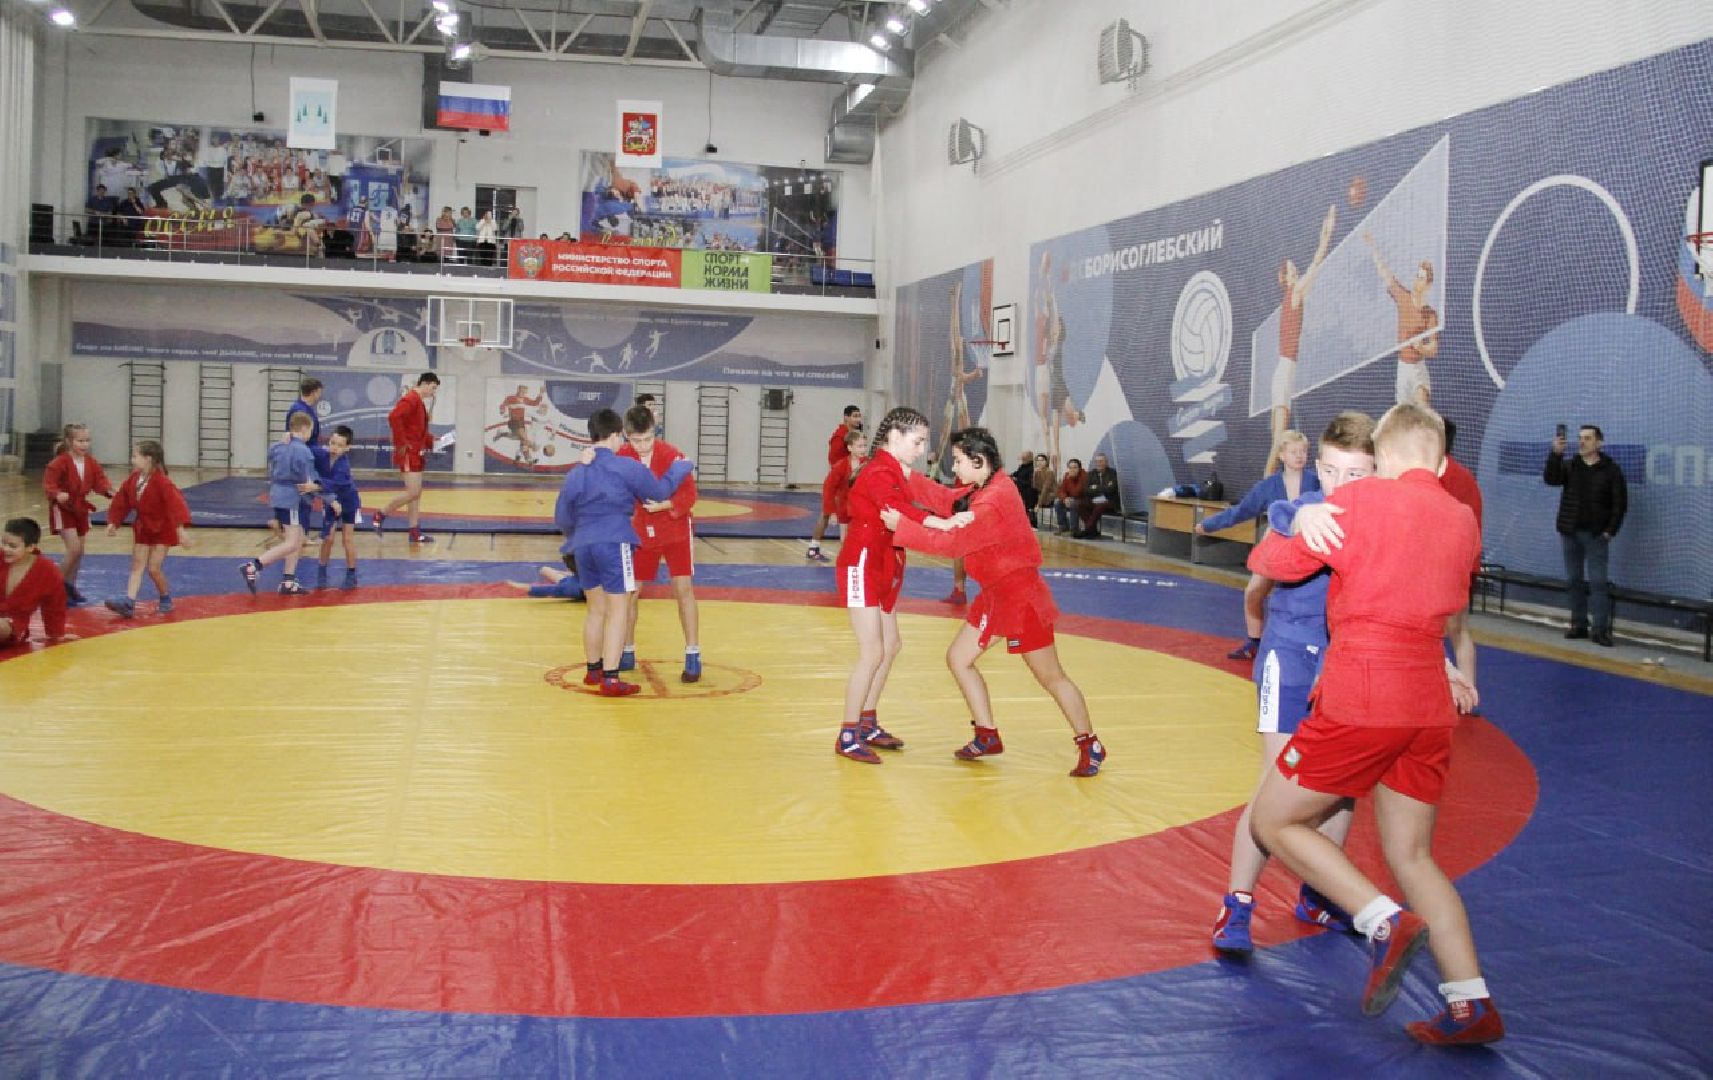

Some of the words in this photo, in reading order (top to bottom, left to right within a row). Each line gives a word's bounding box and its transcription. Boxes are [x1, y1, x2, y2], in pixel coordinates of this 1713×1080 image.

[1085, 219, 1224, 279] БОРИСОГЛЕБСКИЙ
[558, 253, 631, 266] МИНИСТЕРСТВО
[633, 257, 668, 267] СПОРТА
[704, 253, 741, 265] СПОРТ
[552, 263, 614, 276] РОССИЙСКОЙ
[615, 267, 672, 279] ФЕДЕРАЦИИ
[704, 264, 749, 278] НОРМА
[704, 277, 749, 290] ЖИЗНИ
[1645, 444, 1713, 486] СП
